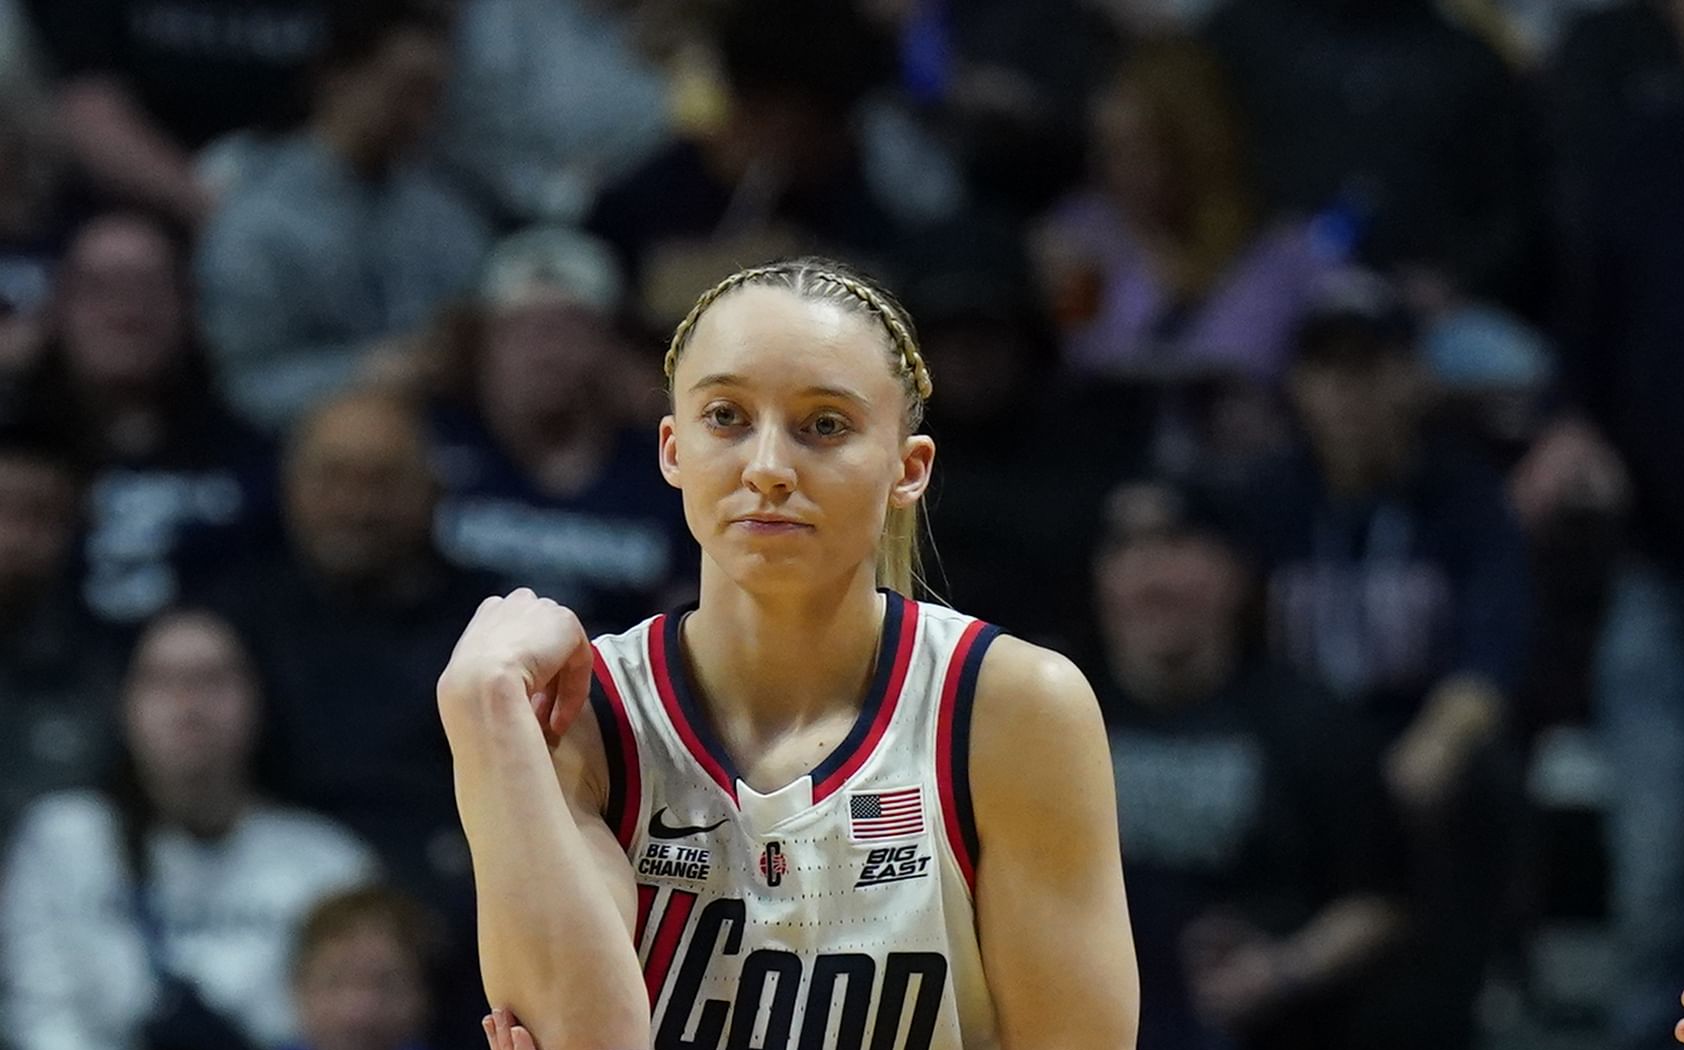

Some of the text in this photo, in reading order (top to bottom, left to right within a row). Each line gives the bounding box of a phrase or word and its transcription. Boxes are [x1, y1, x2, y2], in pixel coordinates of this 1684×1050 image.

[646, 843, 710, 863] BE THE
[866, 844, 918, 864] BIG
[638, 859, 711, 880] CHANGE
[859, 856, 931, 880] EAST
